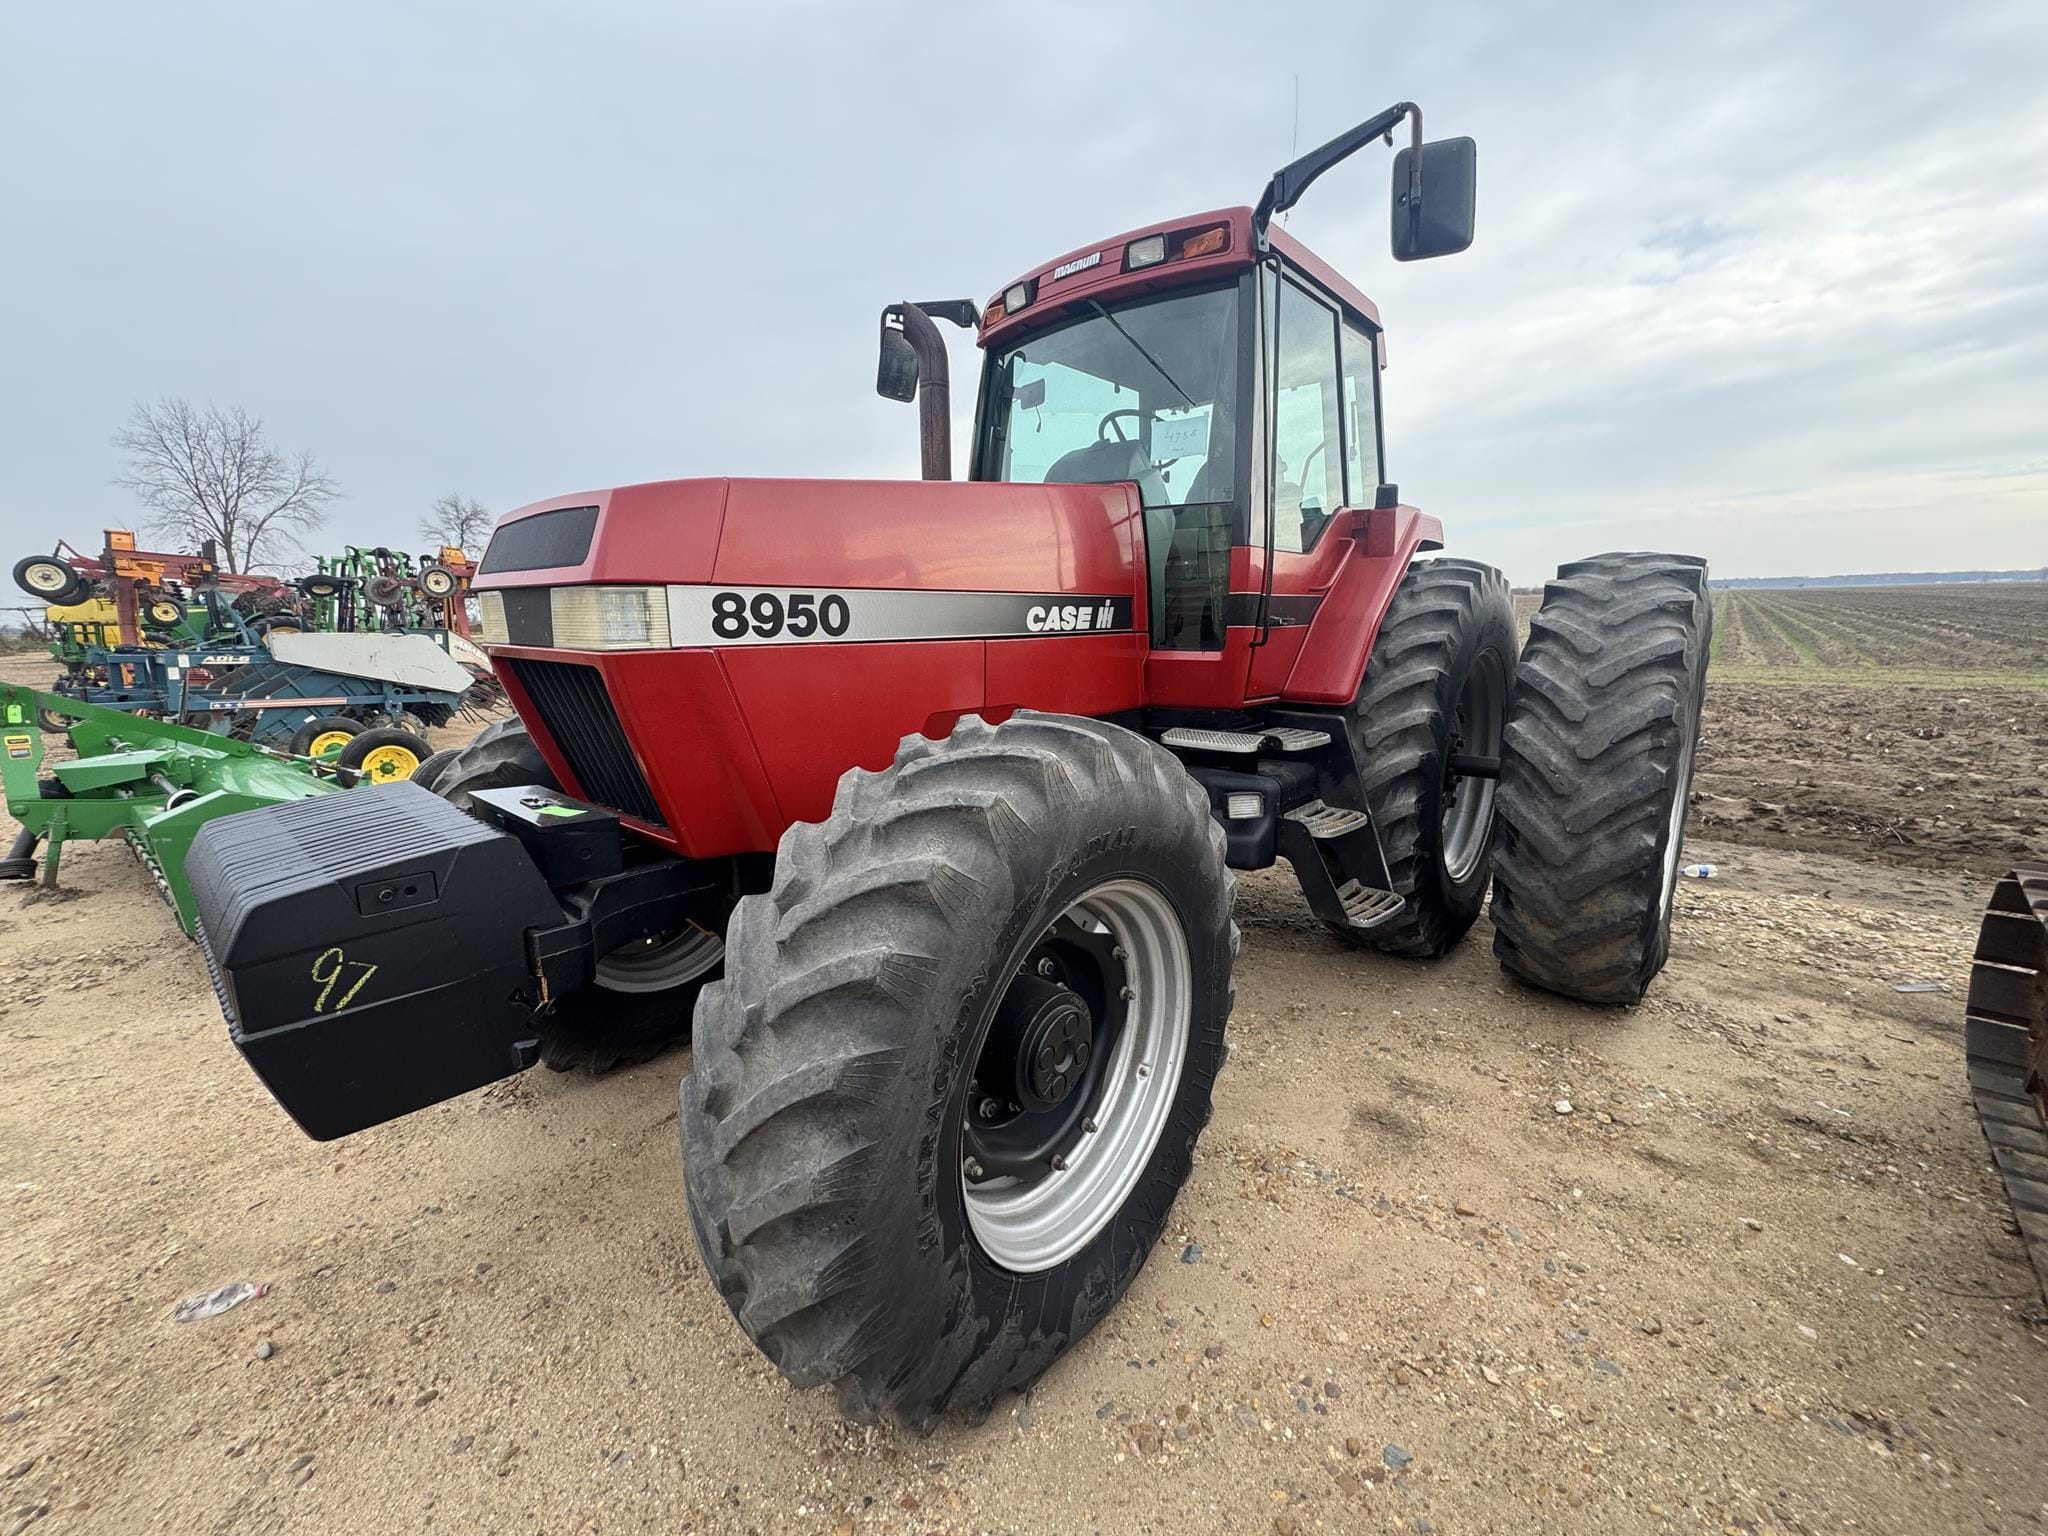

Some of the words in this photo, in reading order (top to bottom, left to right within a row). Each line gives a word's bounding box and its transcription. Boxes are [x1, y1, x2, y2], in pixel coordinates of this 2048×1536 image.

[1053, 251, 1101, 280] MAGNUM
[711, 592, 850, 639] 8950
[1026, 605, 1092, 632] CASE
[311, 946, 380, 1014] 97
[916, 962, 989, 1255] HI-TRACTION
[1045, 825, 1138, 886] RADIAL
